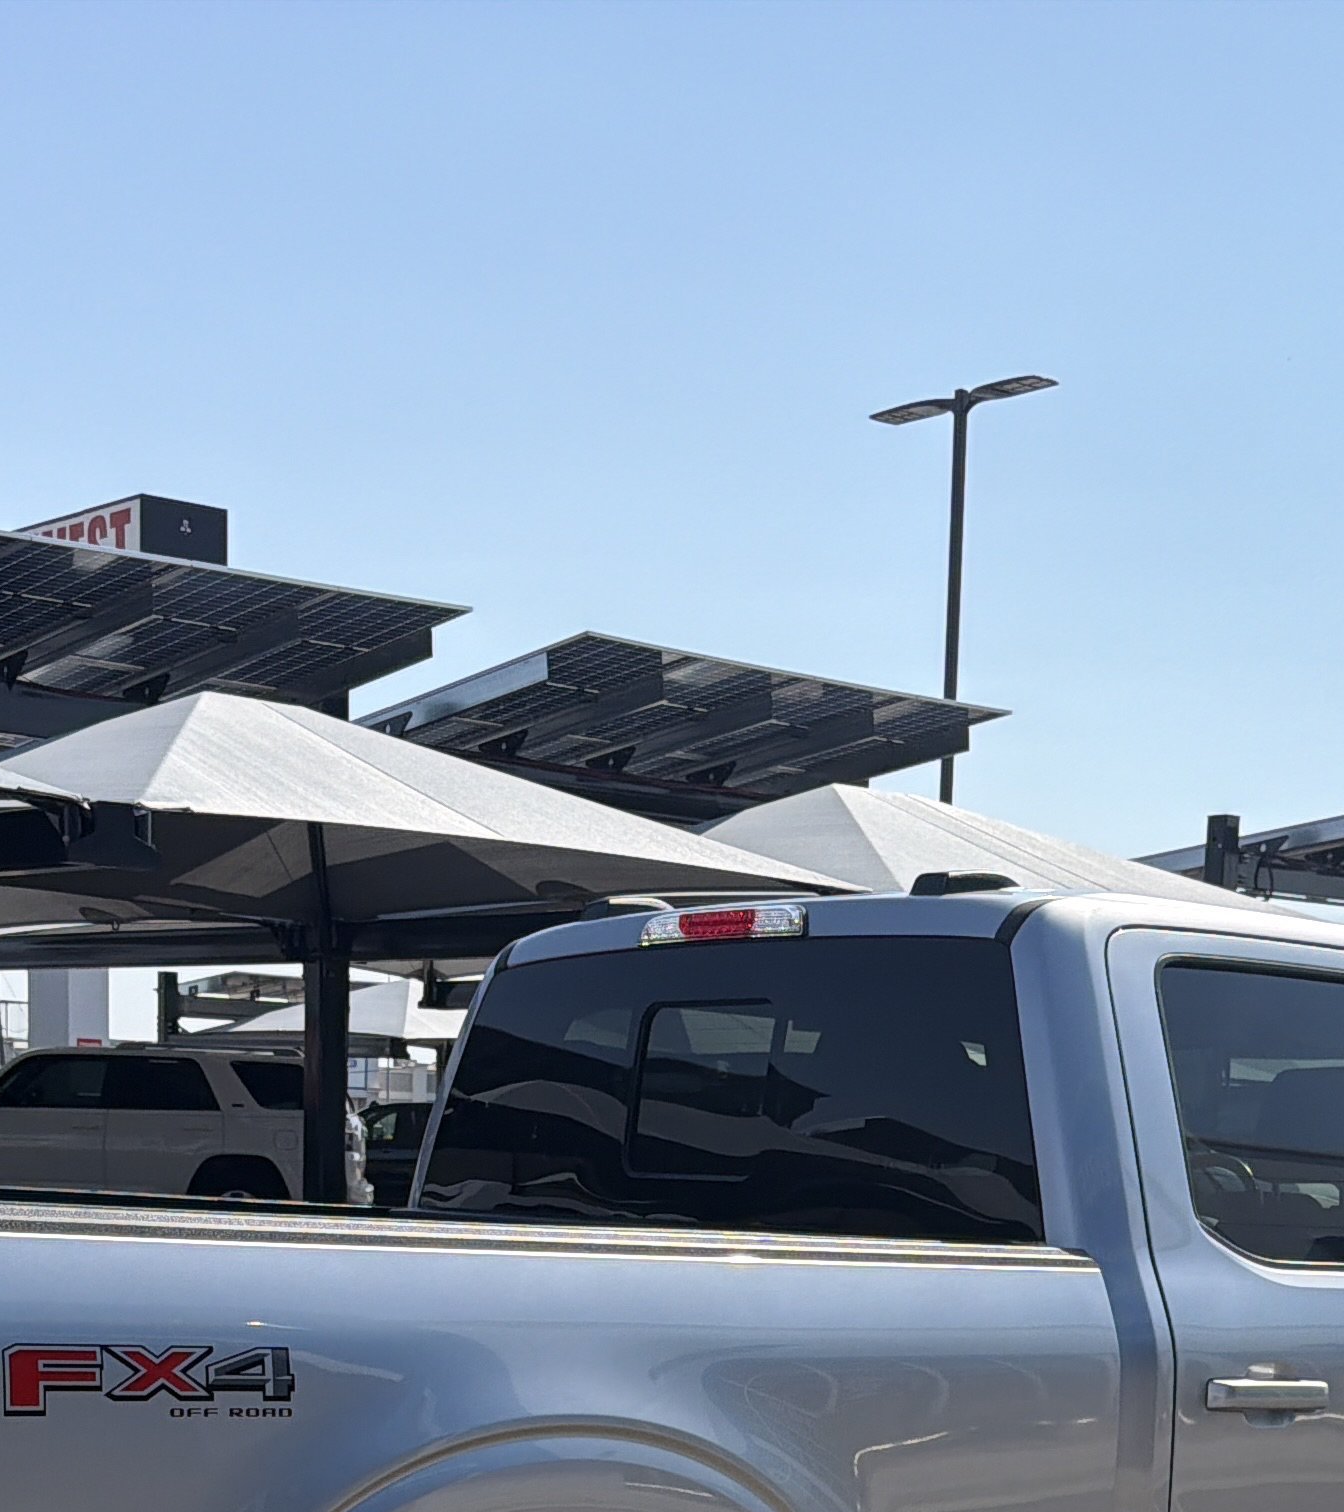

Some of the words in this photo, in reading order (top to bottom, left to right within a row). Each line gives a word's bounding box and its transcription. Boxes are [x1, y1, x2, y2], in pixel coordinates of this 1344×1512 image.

[2, 1343, 294, 1416] FX4
[169, 1407, 219, 1418] OFF
[228, 1407, 294, 1418] ROAD
